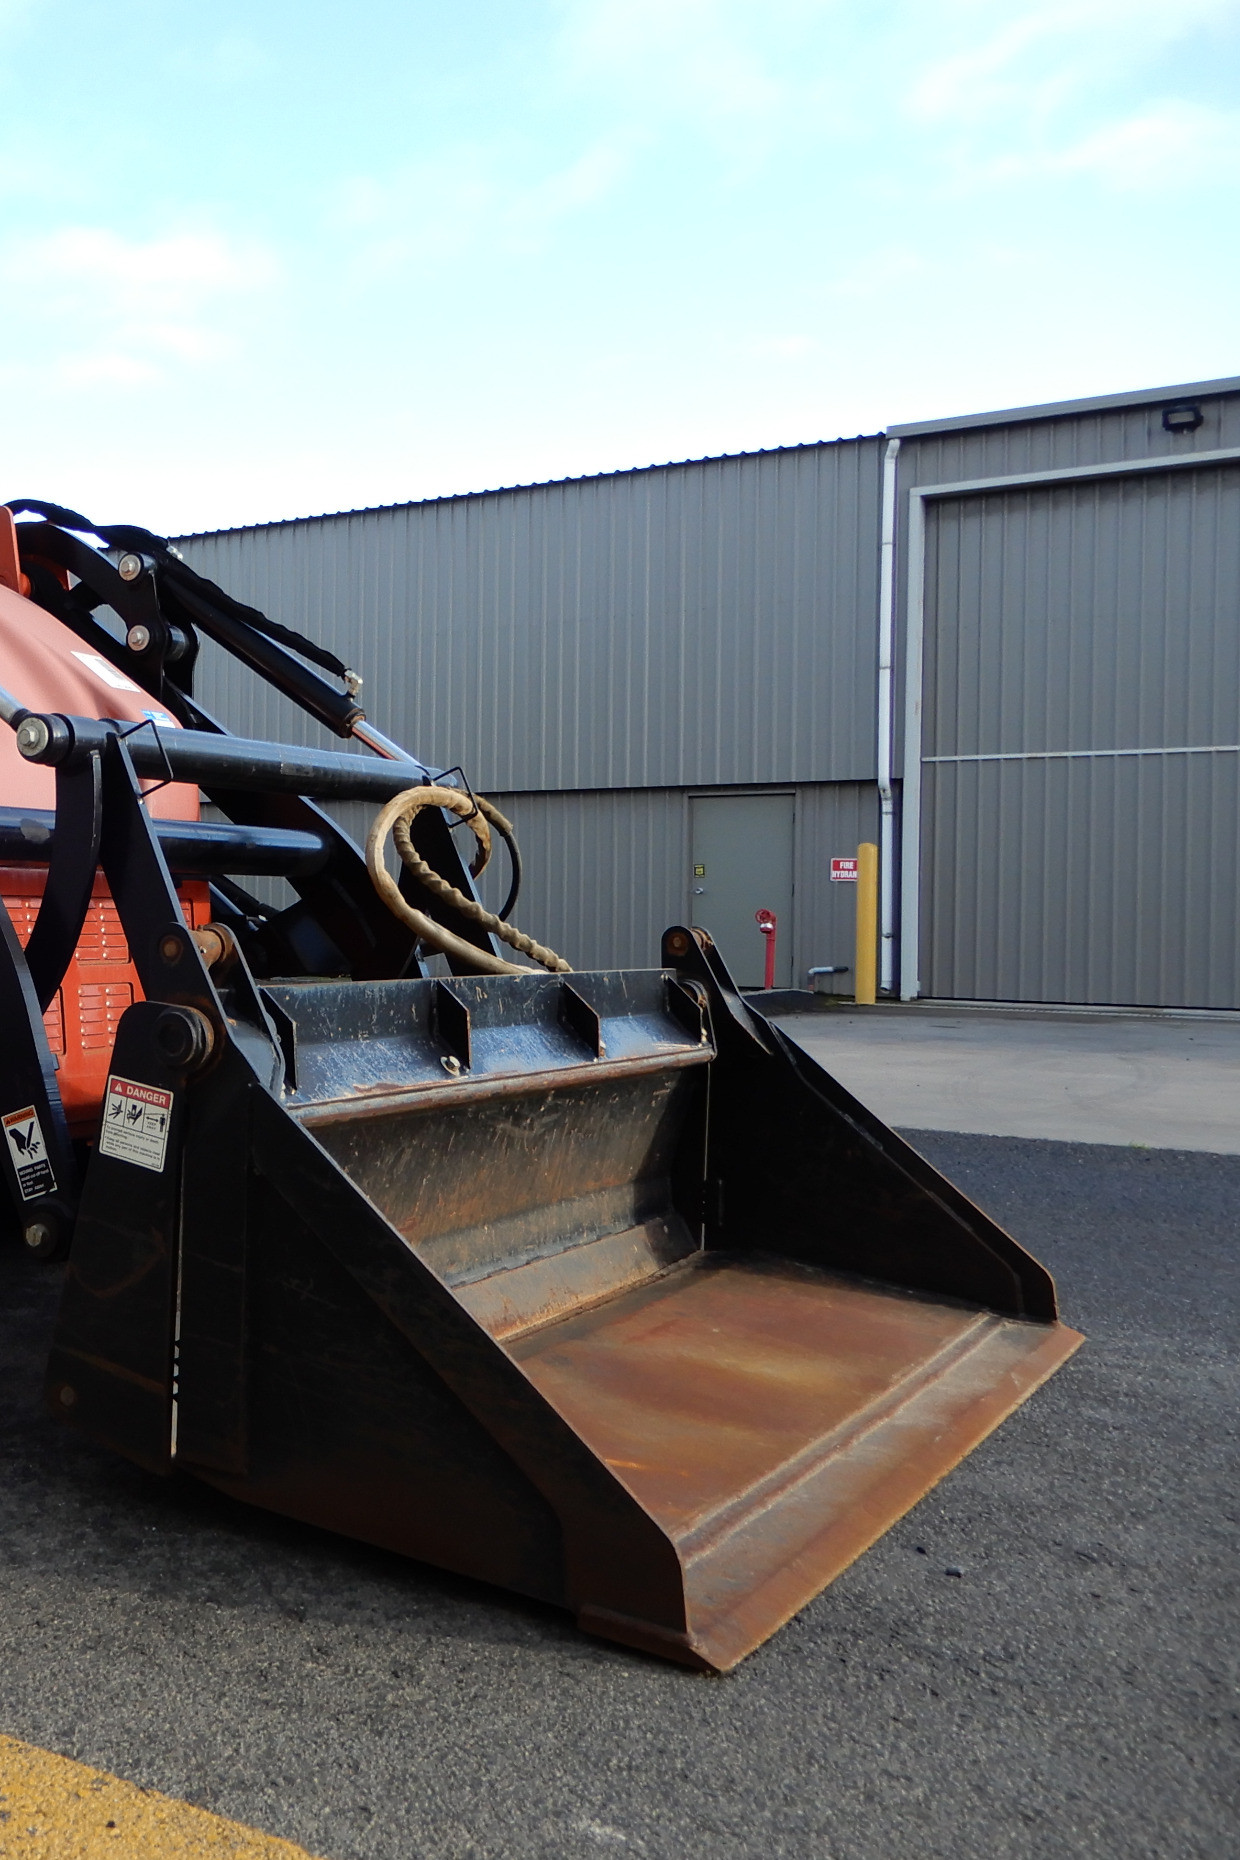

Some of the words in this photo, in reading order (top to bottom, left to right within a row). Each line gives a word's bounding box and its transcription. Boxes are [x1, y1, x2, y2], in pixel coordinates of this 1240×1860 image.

[840, 861, 854, 870] FIRE
[832, 870, 858, 878] HYDRAN
[126, 1085, 166, 1105] DANGER
